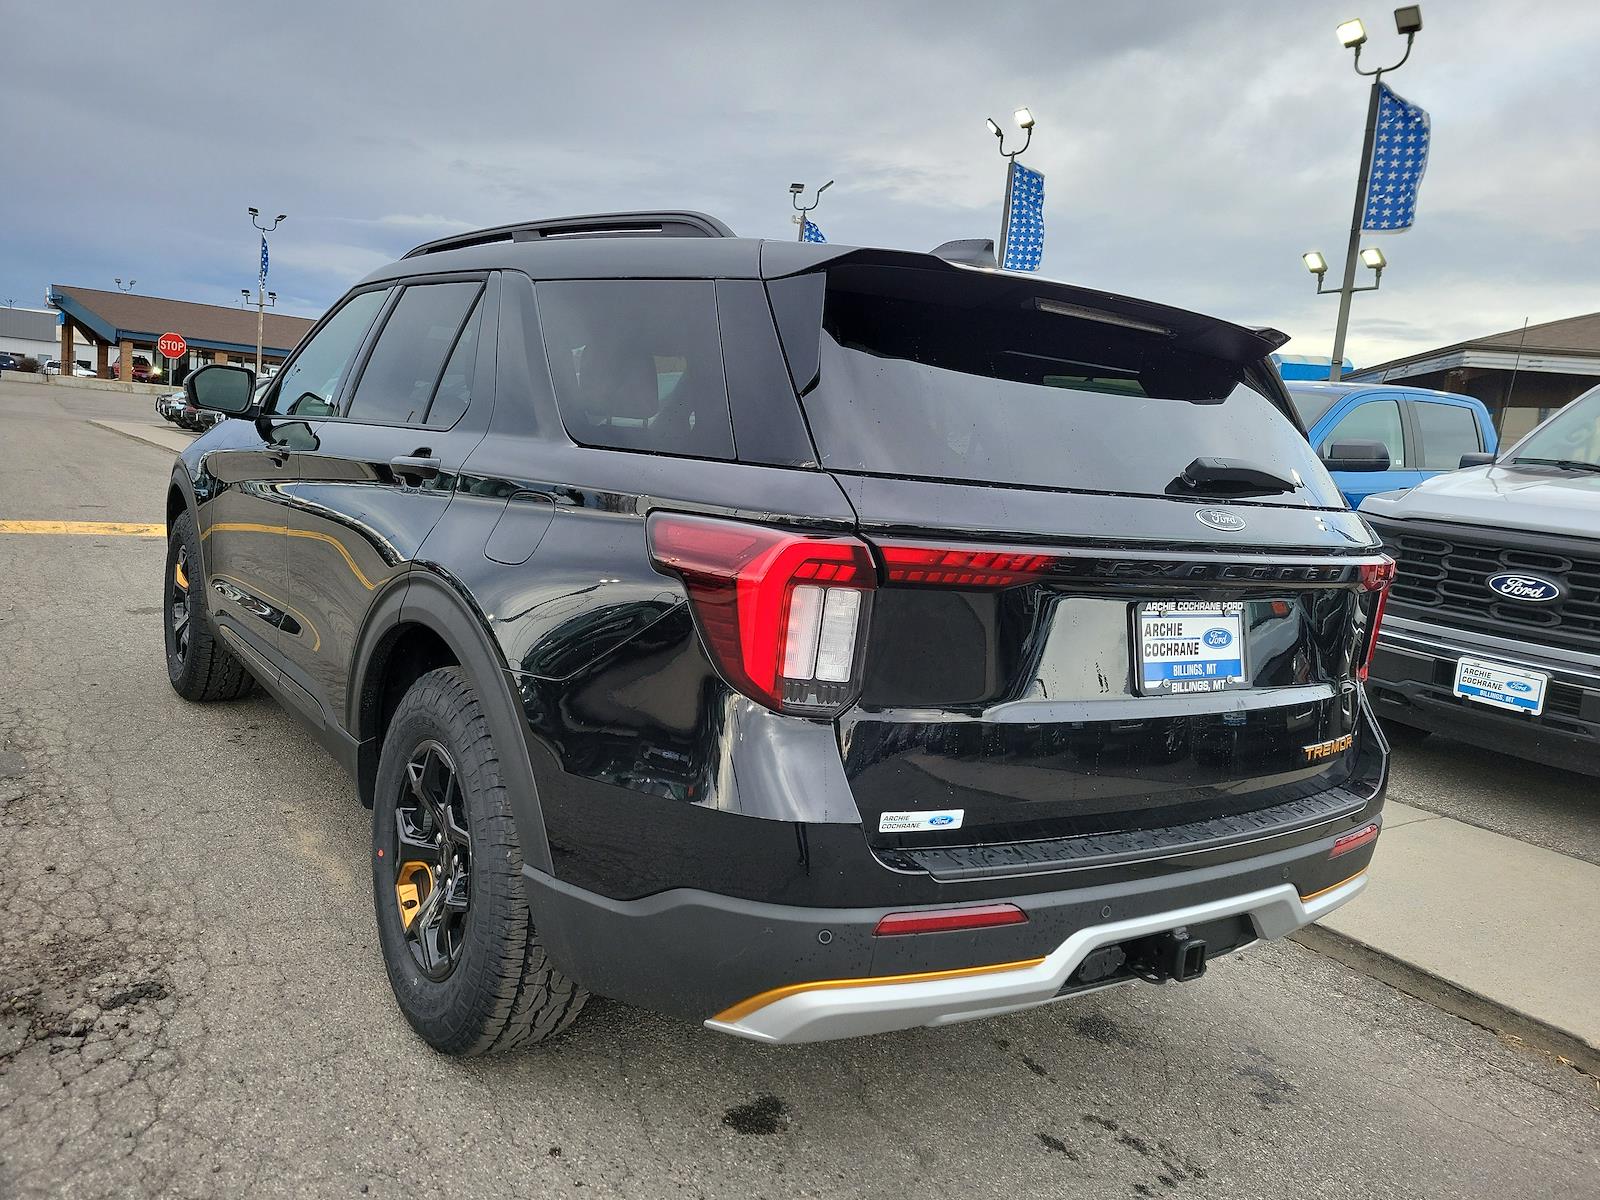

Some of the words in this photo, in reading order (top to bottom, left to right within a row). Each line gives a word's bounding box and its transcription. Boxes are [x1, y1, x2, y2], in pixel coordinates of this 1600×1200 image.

[160, 340, 184, 351] STOP
[1210, 511, 1238, 525] Ford
[1501, 577, 1544, 598] Ford
[1145, 602, 1176, 611] ARCHIE
[1177, 602, 1221, 610] COCHRANE
[1222, 602, 1243, 610] FORD
[1144, 623, 1183, 637] ARCHIE
[1208, 630, 1227, 645] Ford
[1144, 642, 1200, 658] COCHRANE
[1173, 664, 1205, 677] BILLINGS,
[1206, 663, 1217, 675] MT
[1463, 667, 1492, 679] ARCHIE
[1171, 682, 1211, 693] BILLINGS,
[1213, 680, 1226, 690] MT
[1461, 675, 1503, 691] COCHRANE
[1510, 681, 1529, 692] Ford
[1479, 689, 1505, 701] BILLINGS,
[1505, 694, 1515, 704] MT
[1303, 734, 1353, 760] TREMOR
